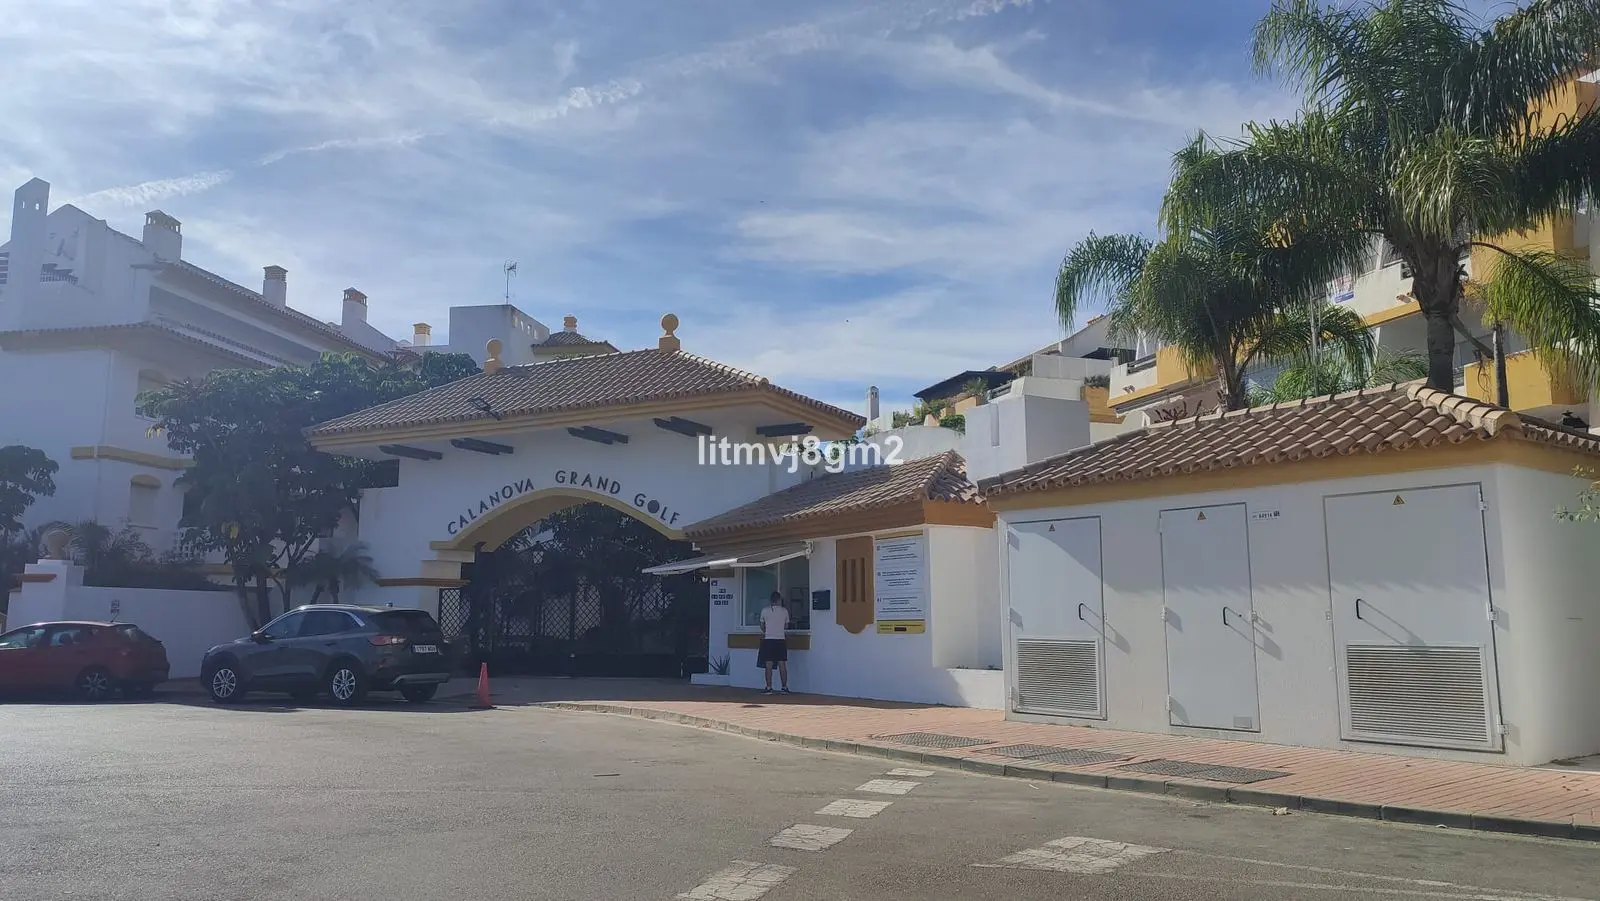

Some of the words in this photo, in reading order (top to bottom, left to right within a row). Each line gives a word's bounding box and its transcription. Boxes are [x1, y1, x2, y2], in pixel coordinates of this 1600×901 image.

[447, 478, 535, 535] CALANOVA
[555, 470, 621, 495] GRAND
[634, 492, 681, 525] GOLF
